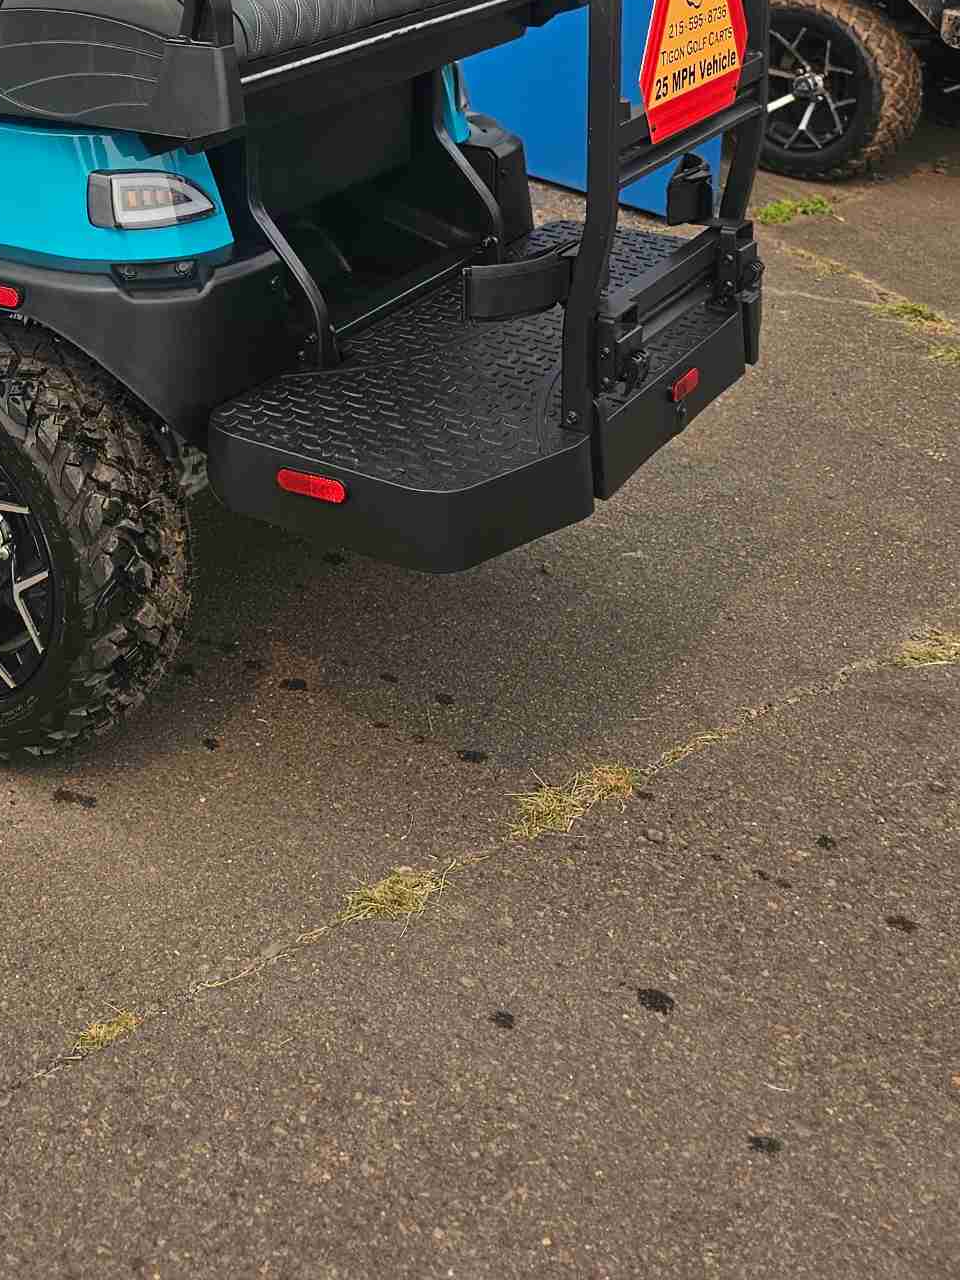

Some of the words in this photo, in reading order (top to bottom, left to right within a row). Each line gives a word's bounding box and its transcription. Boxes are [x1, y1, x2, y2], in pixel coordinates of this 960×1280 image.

[661, 47, 685, 66] TIGON
[687, 36, 707, 55] GOLF
[708, 26, 734, 47] CARTS
[655, 75, 669, 101] 25
[671, 63, 696, 93] MPH
[699, 49, 736, 80] Vehicle
